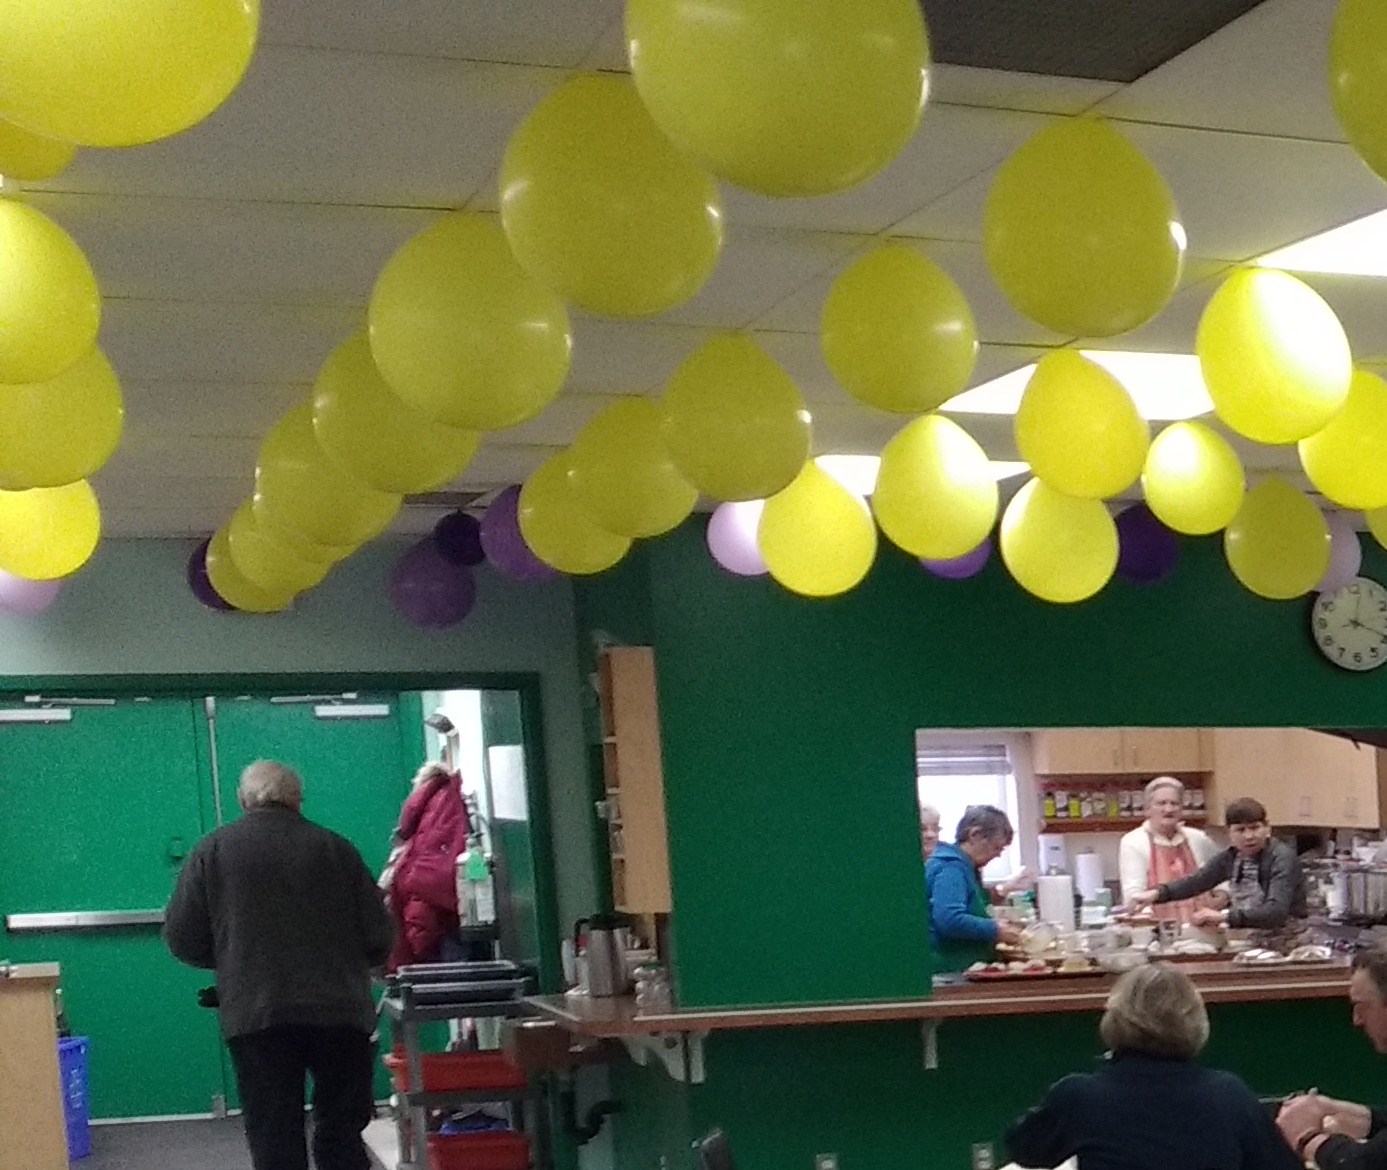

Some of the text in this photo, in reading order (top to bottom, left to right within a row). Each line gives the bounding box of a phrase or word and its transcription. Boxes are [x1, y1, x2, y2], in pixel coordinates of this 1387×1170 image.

[1378, 601, 1387, 611] 2
[1353, 652, 1362, 662] 6
[1369, 646, 1379, 658] 5
